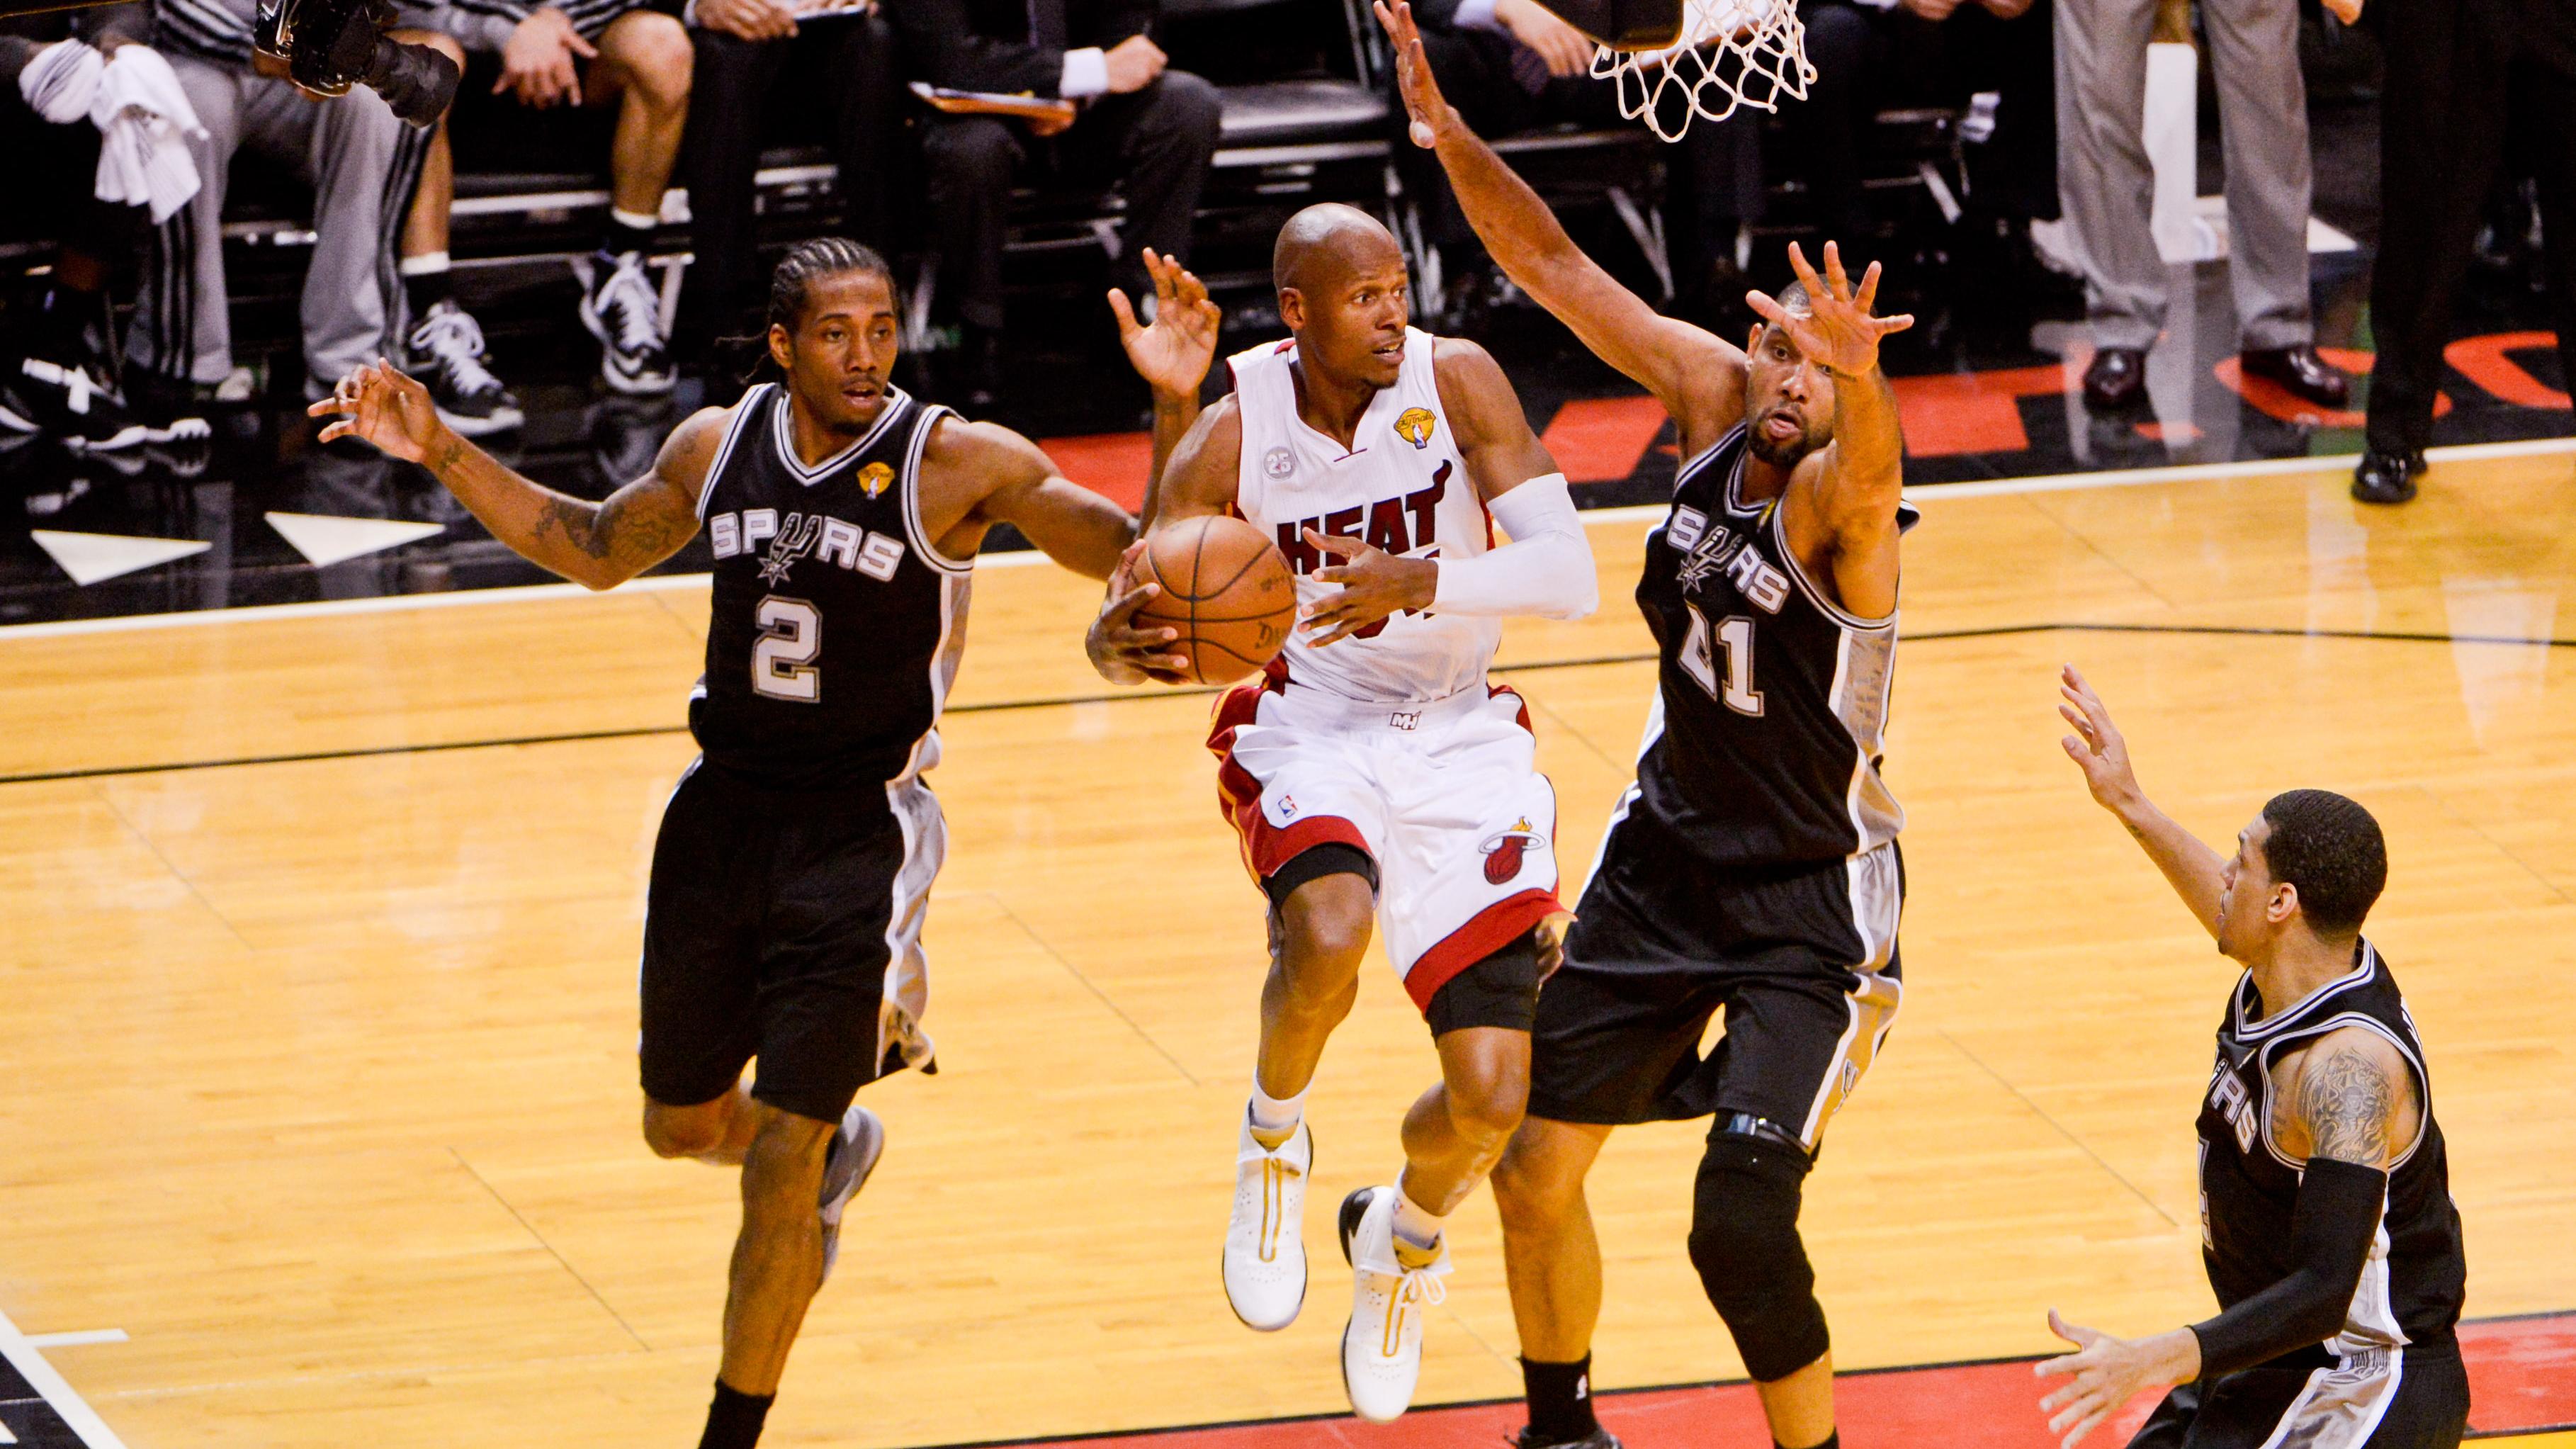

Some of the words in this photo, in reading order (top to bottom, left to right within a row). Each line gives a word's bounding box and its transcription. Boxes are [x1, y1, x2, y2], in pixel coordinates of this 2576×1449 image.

[1267, 453, 1292, 474] 25
[1277, 459, 1452, 575] HEAT
[710, 508, 905, 587] SPURS
[1666, 504, 1791, 615] SURS
[752, 594, 823, 704] 2
